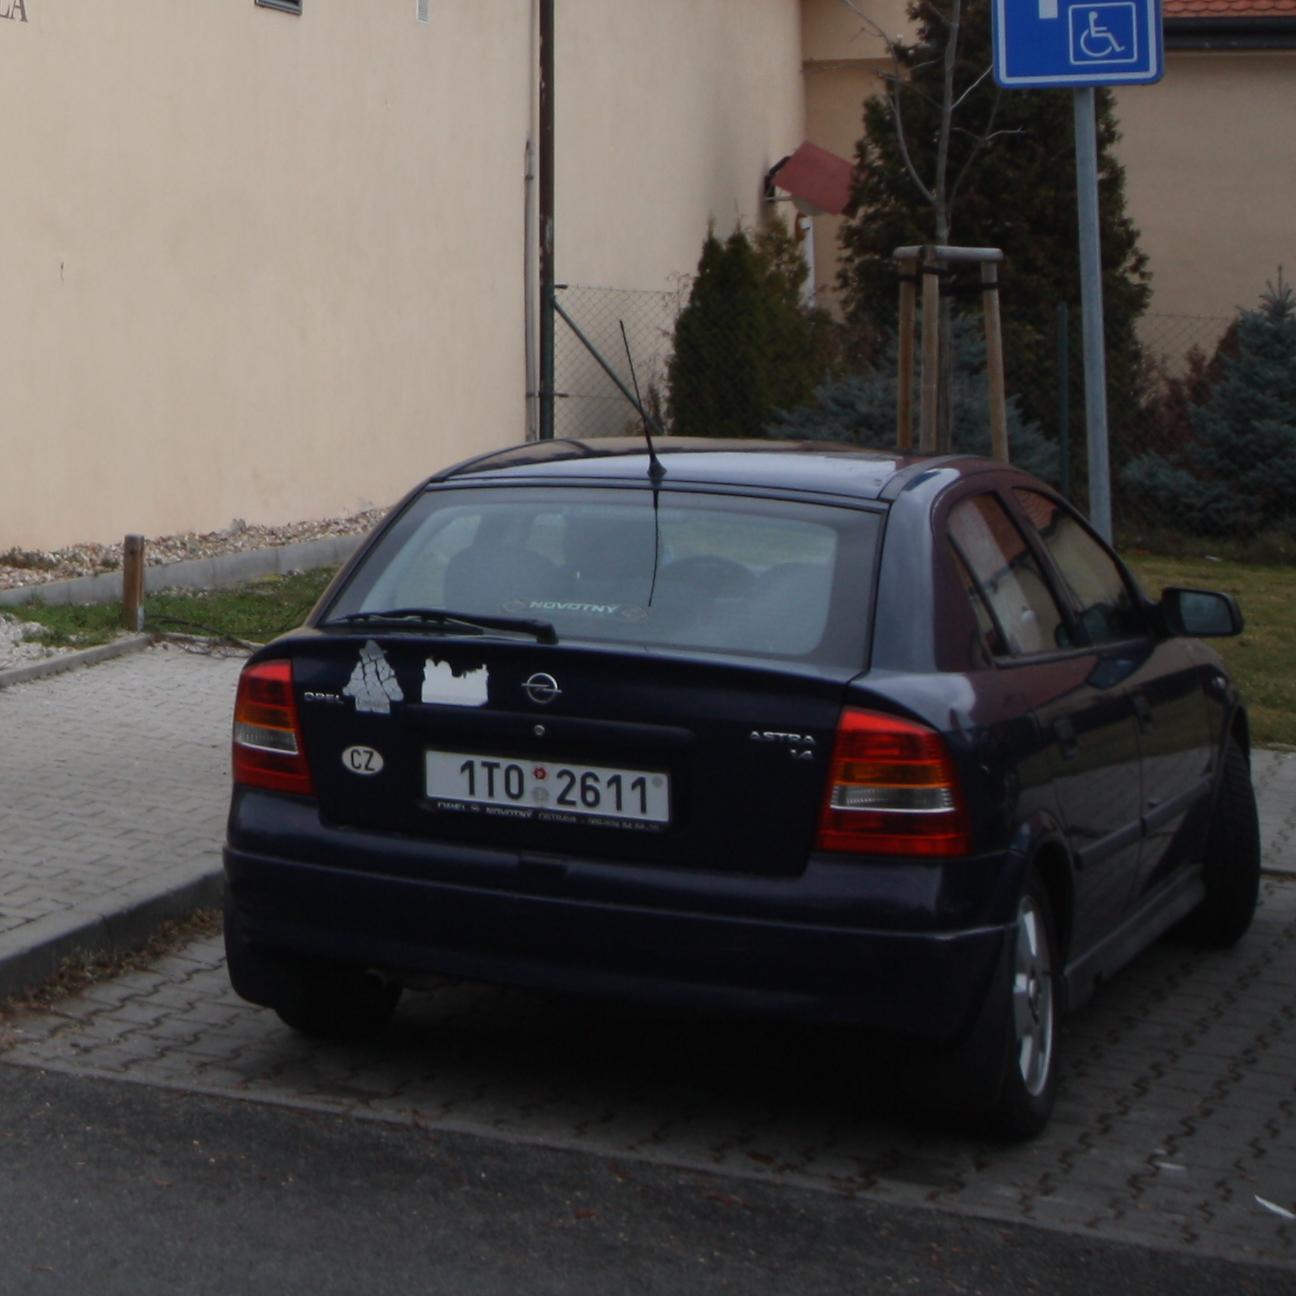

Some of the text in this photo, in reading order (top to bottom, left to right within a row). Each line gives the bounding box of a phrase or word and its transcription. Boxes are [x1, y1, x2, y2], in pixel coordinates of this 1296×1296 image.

[304, 691, 345, 705] OPEL
[751, 731, 816, 745] ASTRA
[350, 749, 376, 772] CZ
[556, 768, 647, 815] 2611
